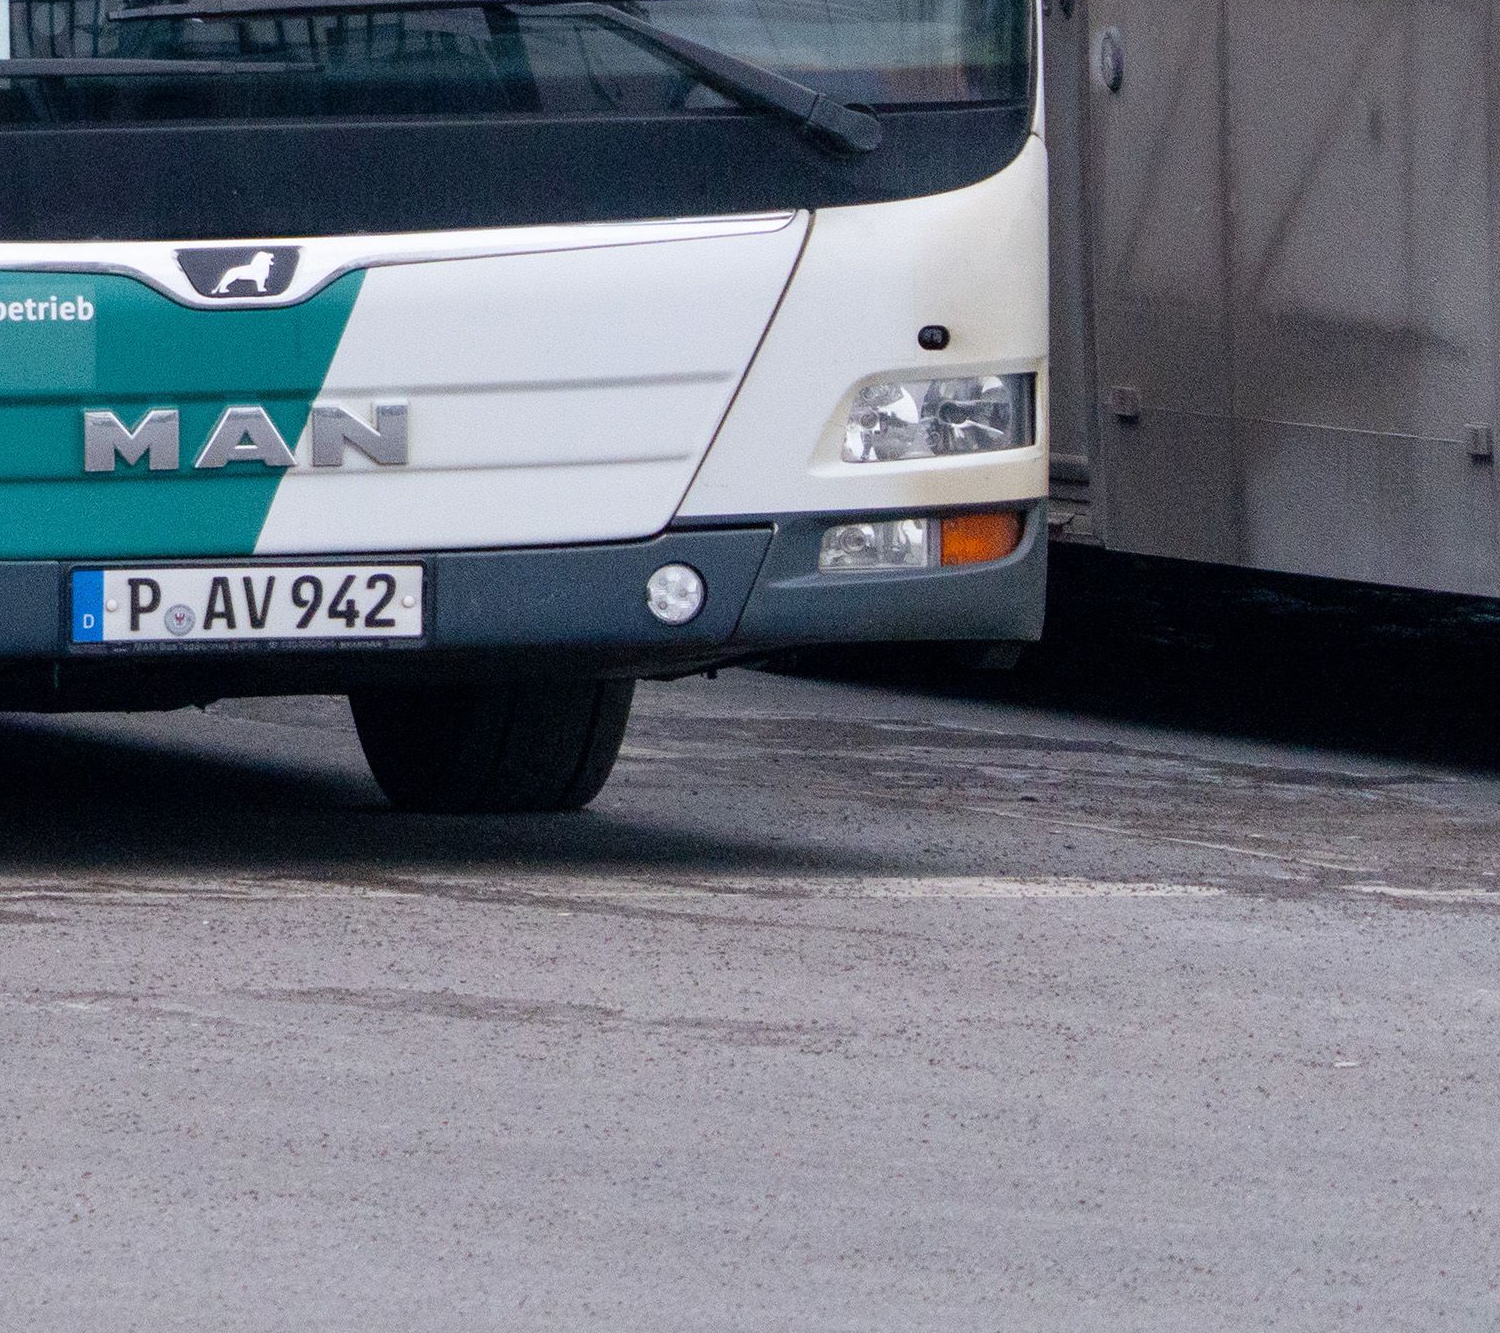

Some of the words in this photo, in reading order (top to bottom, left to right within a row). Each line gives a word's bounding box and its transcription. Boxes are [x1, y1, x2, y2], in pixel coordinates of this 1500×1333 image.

[83, 399, 409, 473] MAN
[83, 614, 95, 629] D
[127, 577, 162, 632] P
[203, 575, 276, 630] AV
[291, 573, 397, 629] 942
